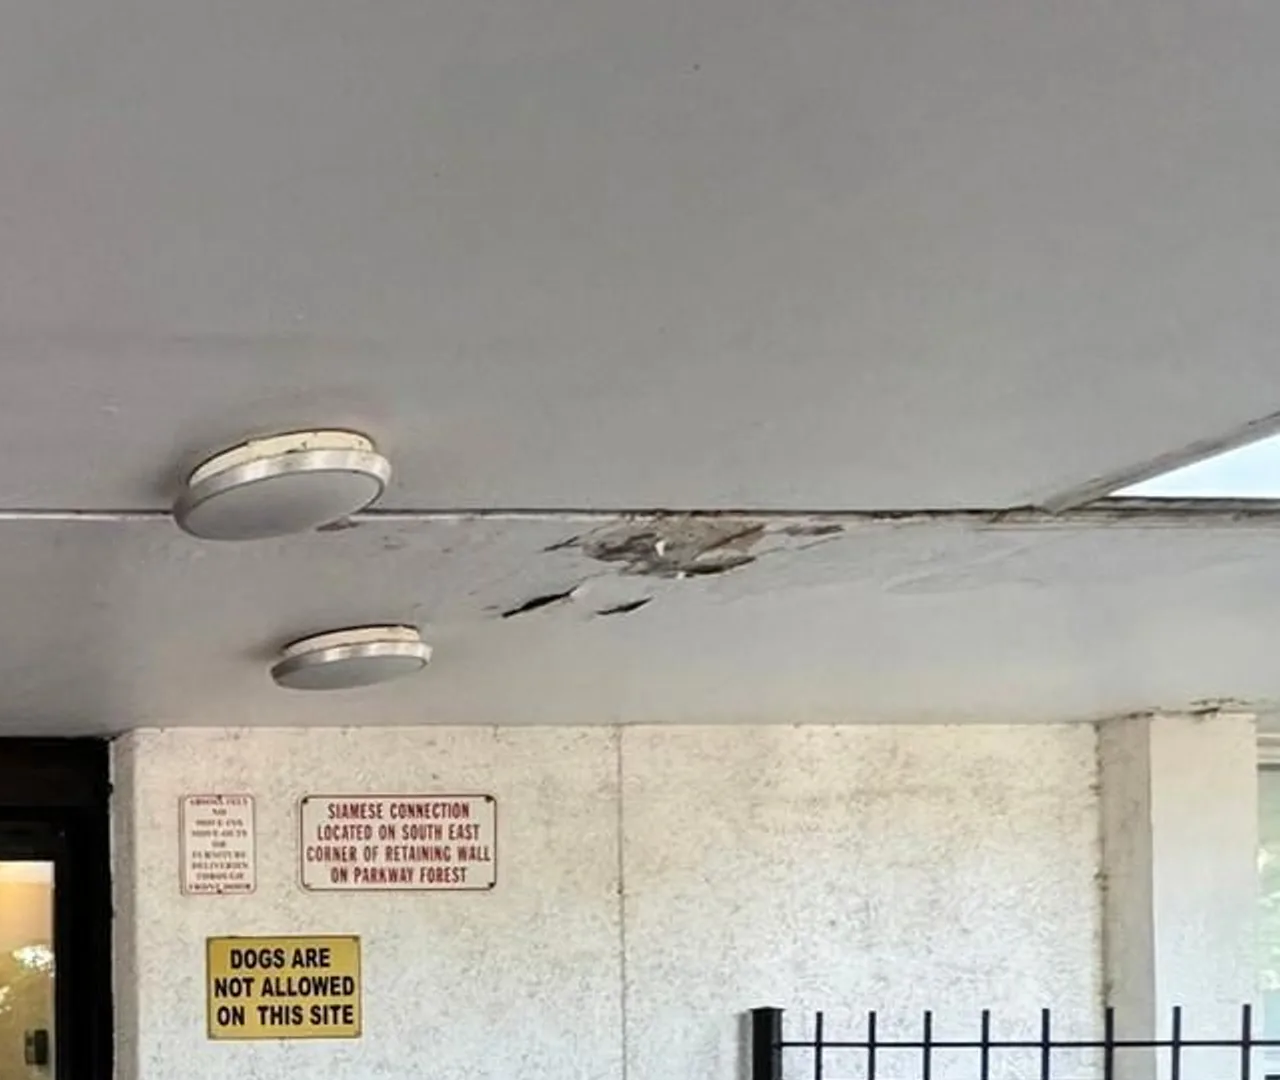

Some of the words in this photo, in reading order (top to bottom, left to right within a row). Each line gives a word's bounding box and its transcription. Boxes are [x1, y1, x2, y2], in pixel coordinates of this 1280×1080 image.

[328, 803, 383, 819] SIAMESE
[390, 803, 470, 819] CONNECTION
[317, 824, 372, 841] LOCATED
[378, 825, 395, 840] ON
[402, 824, 443, 841] SOUTH
[448, 824, 481, 841] EAST
[307, 846, 358, 863] CORNER
[363, 846, 379, 862] OF
[385, 846, 452, 862] RETAINING
[457, 846, 491, 862] WALL
[331, 867, 348, 883] ON
[354, 867, 414, 883] PARKWAY
[420, 867, 468, 883] FOREST
[230, 949, 285, 969] DOGS
[291, 948, 331, 968] ARE
[214, 977, 255, 997] NOT
[261, 976, 355, 997] ALLOWED
[217, 1006, 245, 1026] ON
[257, 1005, 304, 1025] THIS
[310, 1005, 354, 1025] SITE
